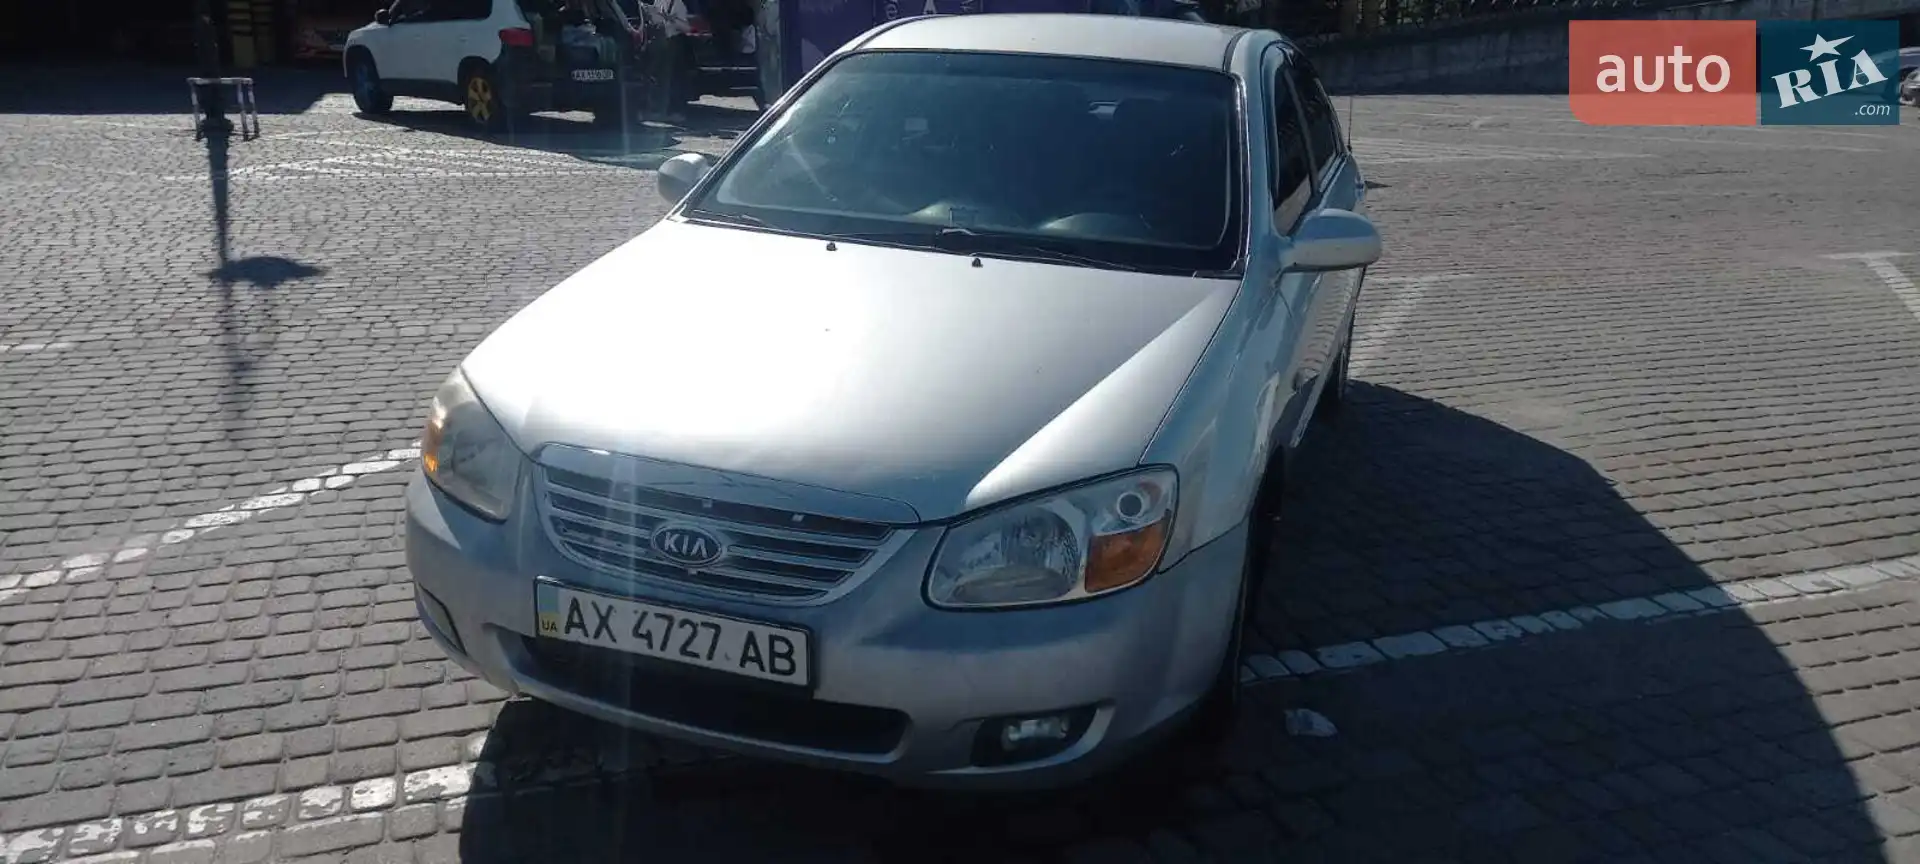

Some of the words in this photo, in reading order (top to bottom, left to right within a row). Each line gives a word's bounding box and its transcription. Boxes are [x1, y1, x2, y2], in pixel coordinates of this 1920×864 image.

[664, 531, 708, 559] KIA
[541, 619, 558, 633] UA
[564, 596, 617, 644] AX
[631, 608, 722, 662] 4727
[738, 630, 797, 677] AB
